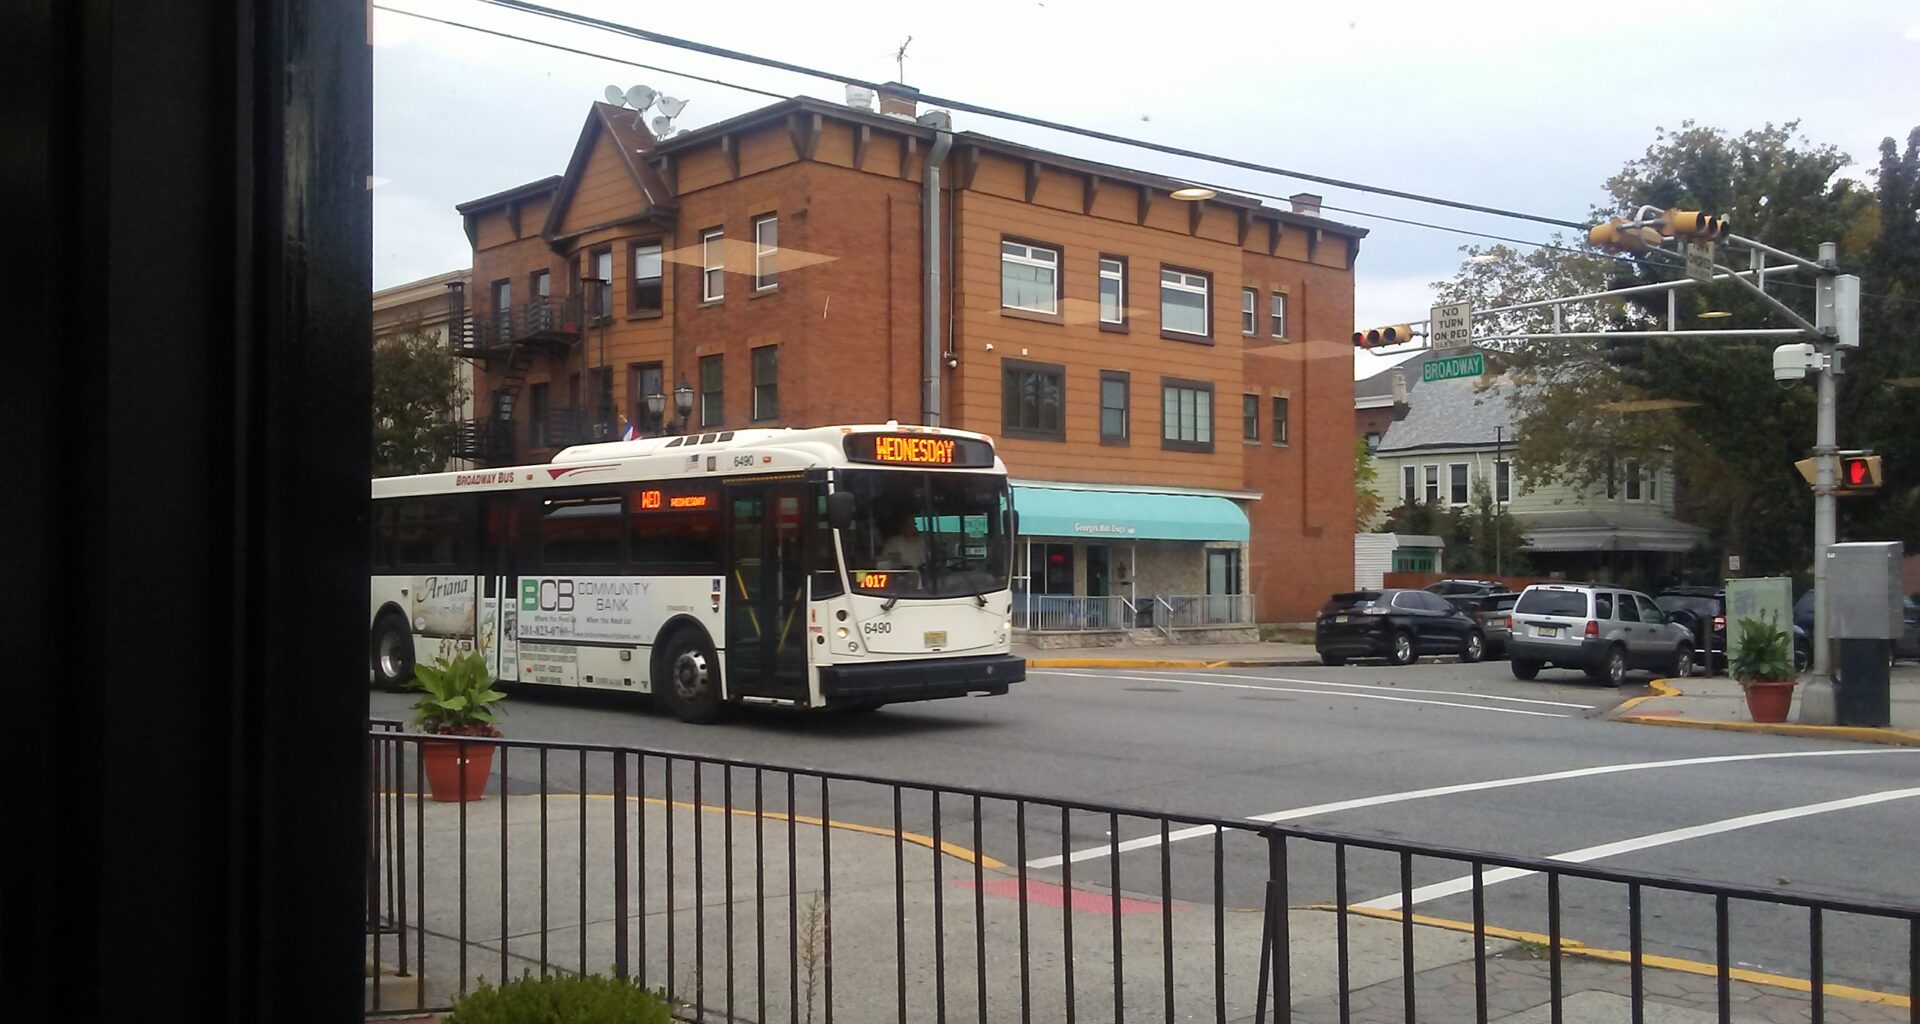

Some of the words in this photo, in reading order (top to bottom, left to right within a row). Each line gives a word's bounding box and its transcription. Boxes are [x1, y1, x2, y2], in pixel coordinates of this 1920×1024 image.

[1442, 308, 1458, 317] NO
[1439, 318, 1463, 329] TURN
[1434, 331, 1447, 341] ON
[1450, 328, 1467, 339] RED
[1424, 357, 1480, 380] BROADWAY
[876, 437, 955, 463] WEDNESDAY
[734, 455, 754, 467] 6490
[456, 474, 496, 486] BROADWAY
[498, 472, 514, 484] BUS
[642, 491, 660, 508] WED
[416, 576, 468, 603] Ariana
[521, 579, 575, 612] BCB
[578, 582, 650, 596] COMMUNITY
[596, 598, 629, 612] BANK
[864, 622, 892, 634] 6490
